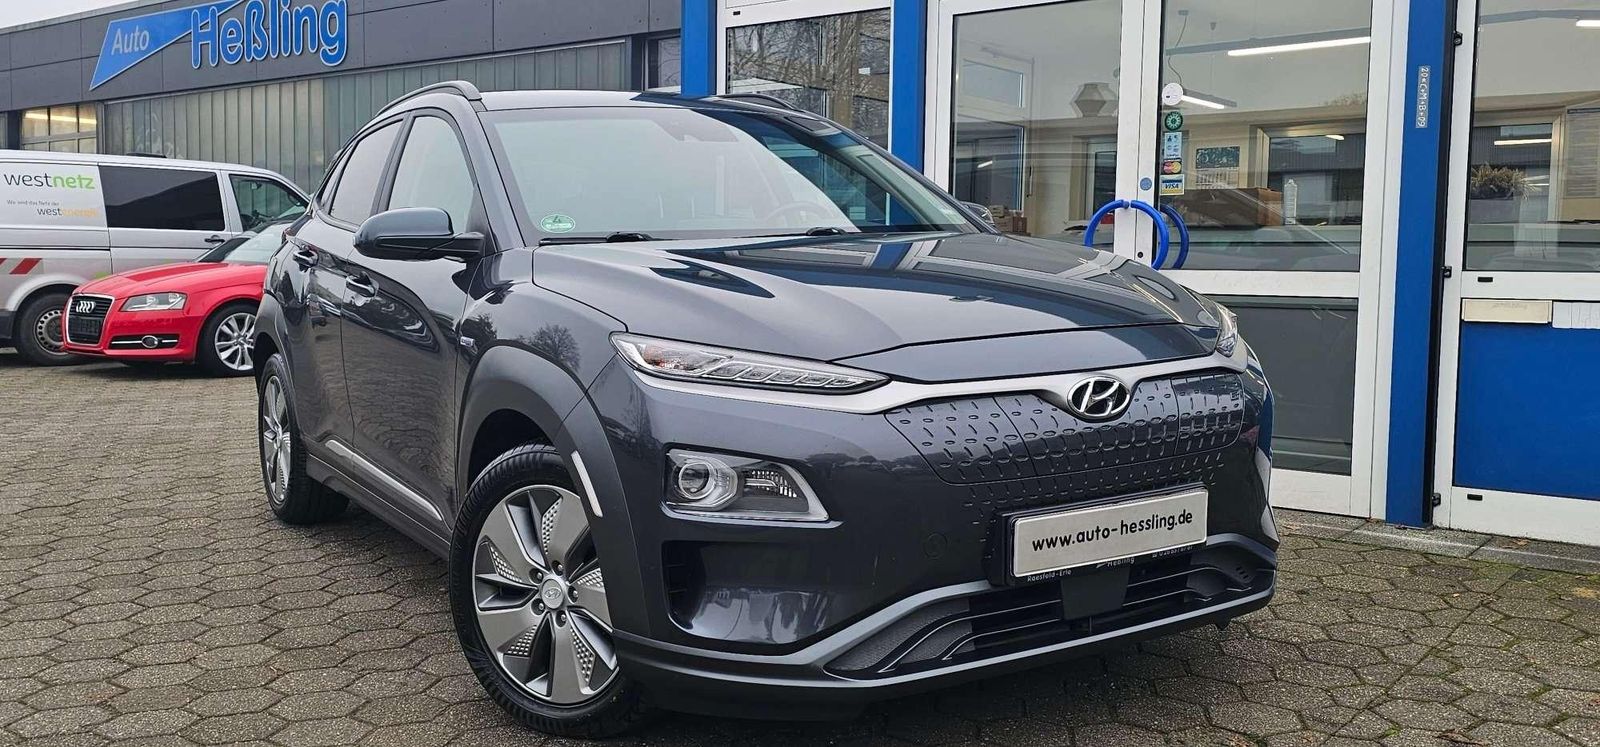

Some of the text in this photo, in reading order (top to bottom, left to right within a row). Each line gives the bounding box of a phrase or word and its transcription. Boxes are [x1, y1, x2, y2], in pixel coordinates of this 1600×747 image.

[111, 0, 348, 69] Auto Heßling
[4, 173, 96, 190] westnetz
[1032, 509, 1193, 551] www.auto-hessling.de
